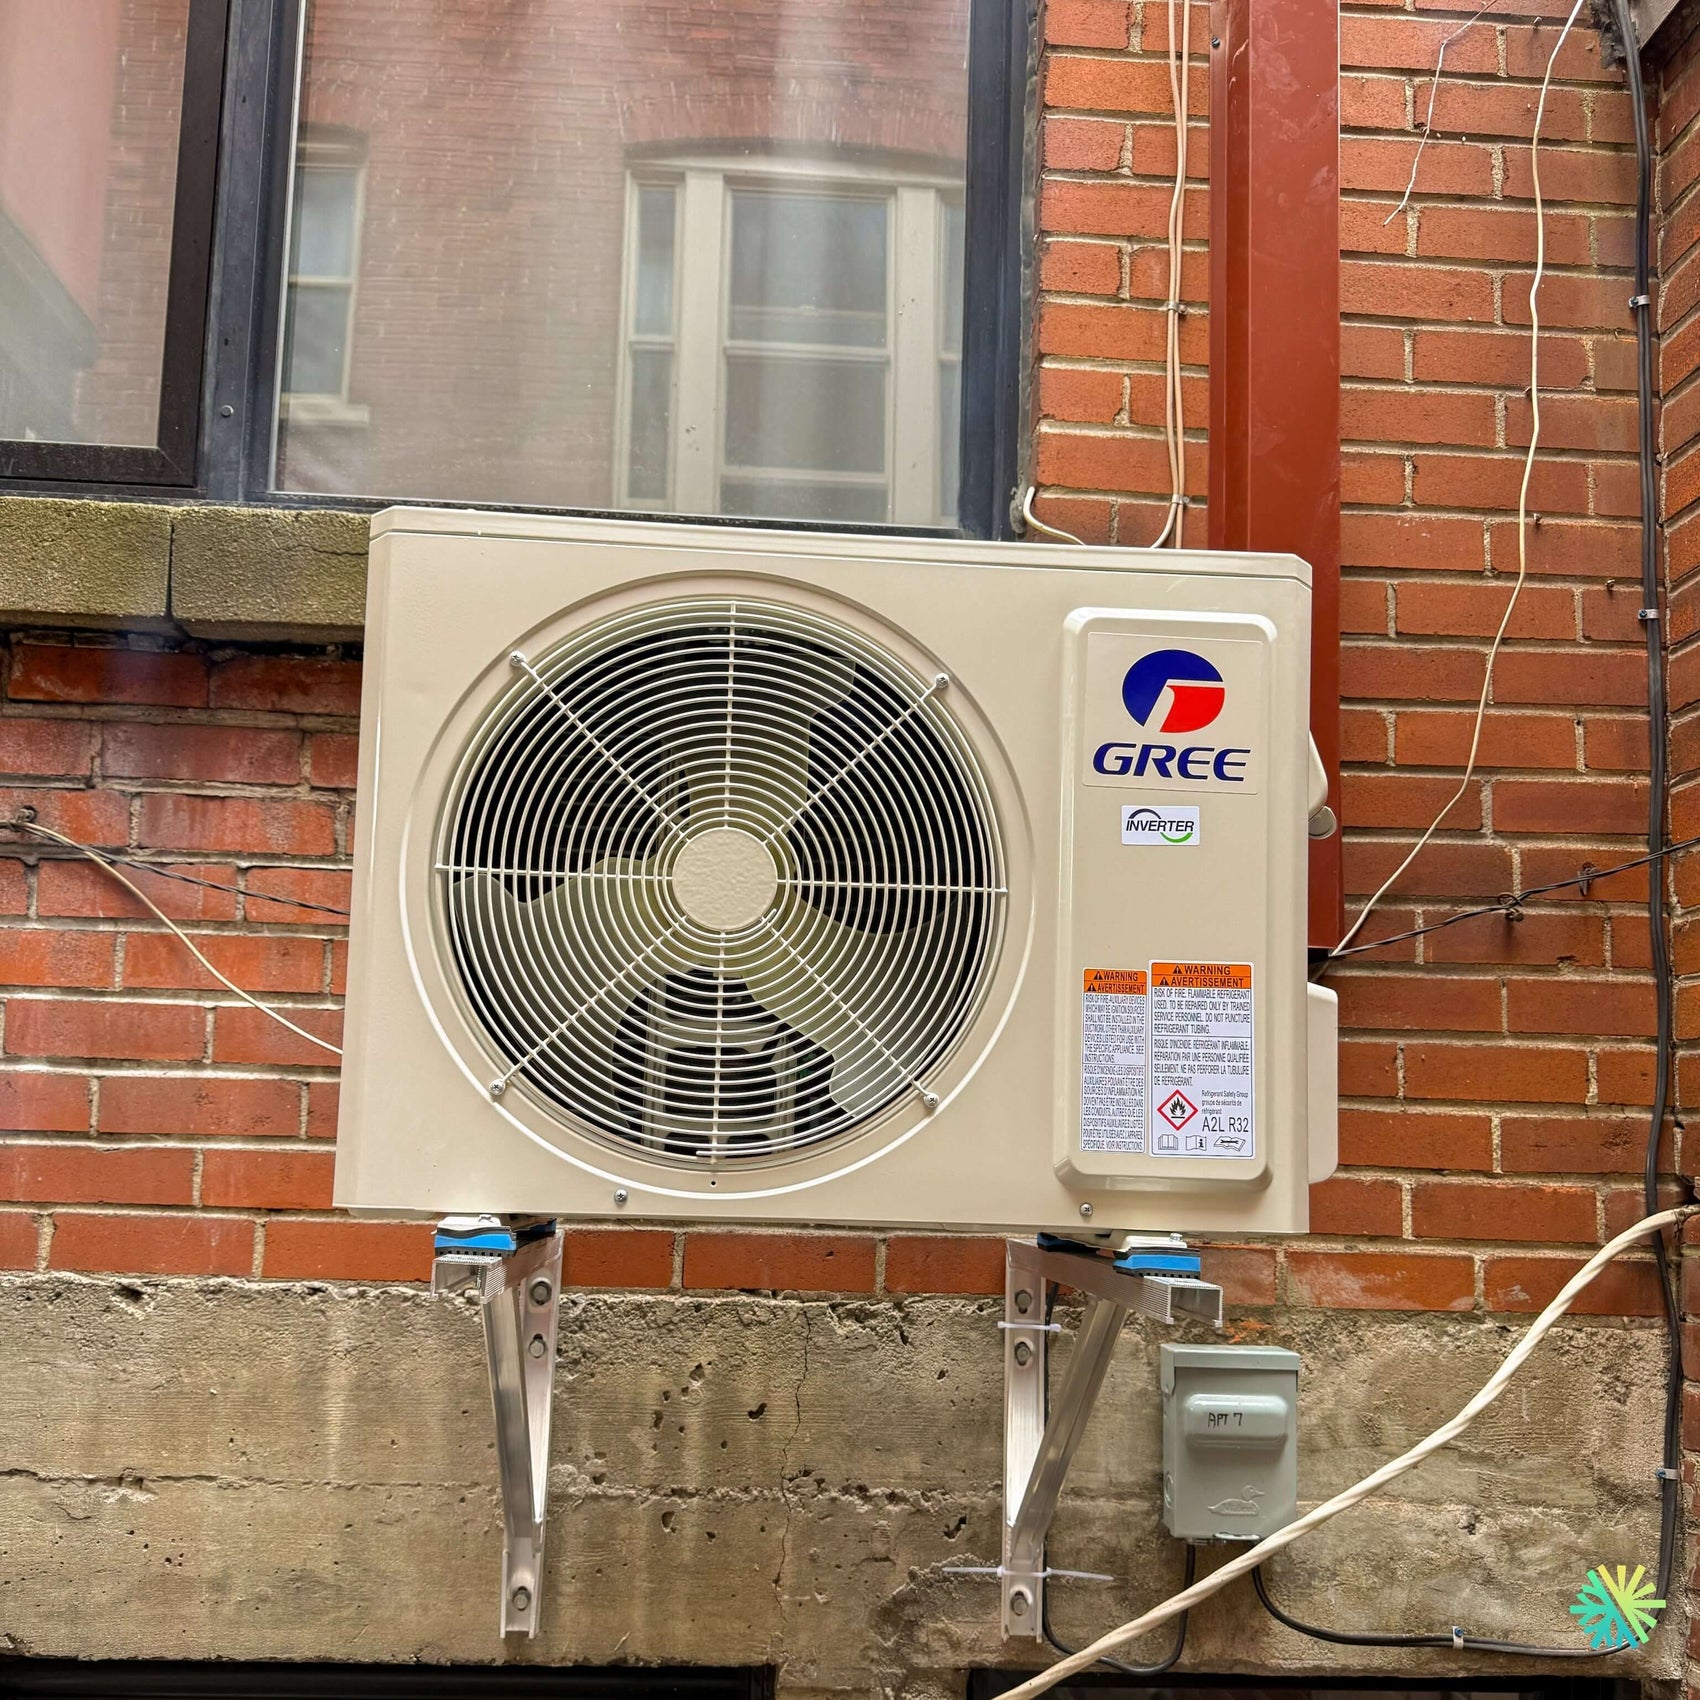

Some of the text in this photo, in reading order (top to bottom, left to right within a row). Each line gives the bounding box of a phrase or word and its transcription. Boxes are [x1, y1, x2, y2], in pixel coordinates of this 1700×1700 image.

[1093, 742, 1251, 781] GREE
[1126, 820, 1194, 832] INVERTER
[1104, 971, 1138, 981] WARNING
[1184, 966, 1230, 975] WARNING
[1171, 977, 1244, 988] AVERTISSEMENT
[1098, 983, 1144, 994] AVERTISSEMENT
[1154, 988, 1166, 997] RISK
[1166, 988, 1173, 998] OF
[1188, 989, 1216, 998] FLAMMABLE
[1217, 989, 1249, 999] REFRIGERANT
[1170, 1000, 1176, 1010] TO
[1177, 1000, 1184, 1010] BE
[1185, 1001, 1207, 1010] REPAIRED
[1209, 1001, 1221, 1010] ONLY
[1223, 1001, 1229, 1011] BY
[1230, 1001, 1249, 1011] TRAINED
[1154, 1012, 1174, 1021] SERVICE
[1206, 1013, 1212, 1022] DO
[1214, 1013, 1224, 1022] NOT
[1225, 1013, 1250, 1023] PUNCTURE
[1154, 1024, 1189, 1034] REFRIGERANT
[1202, 1116, 1248, 1132] A2L R32
[1208, 1412, 1242, 1428] APT 7
